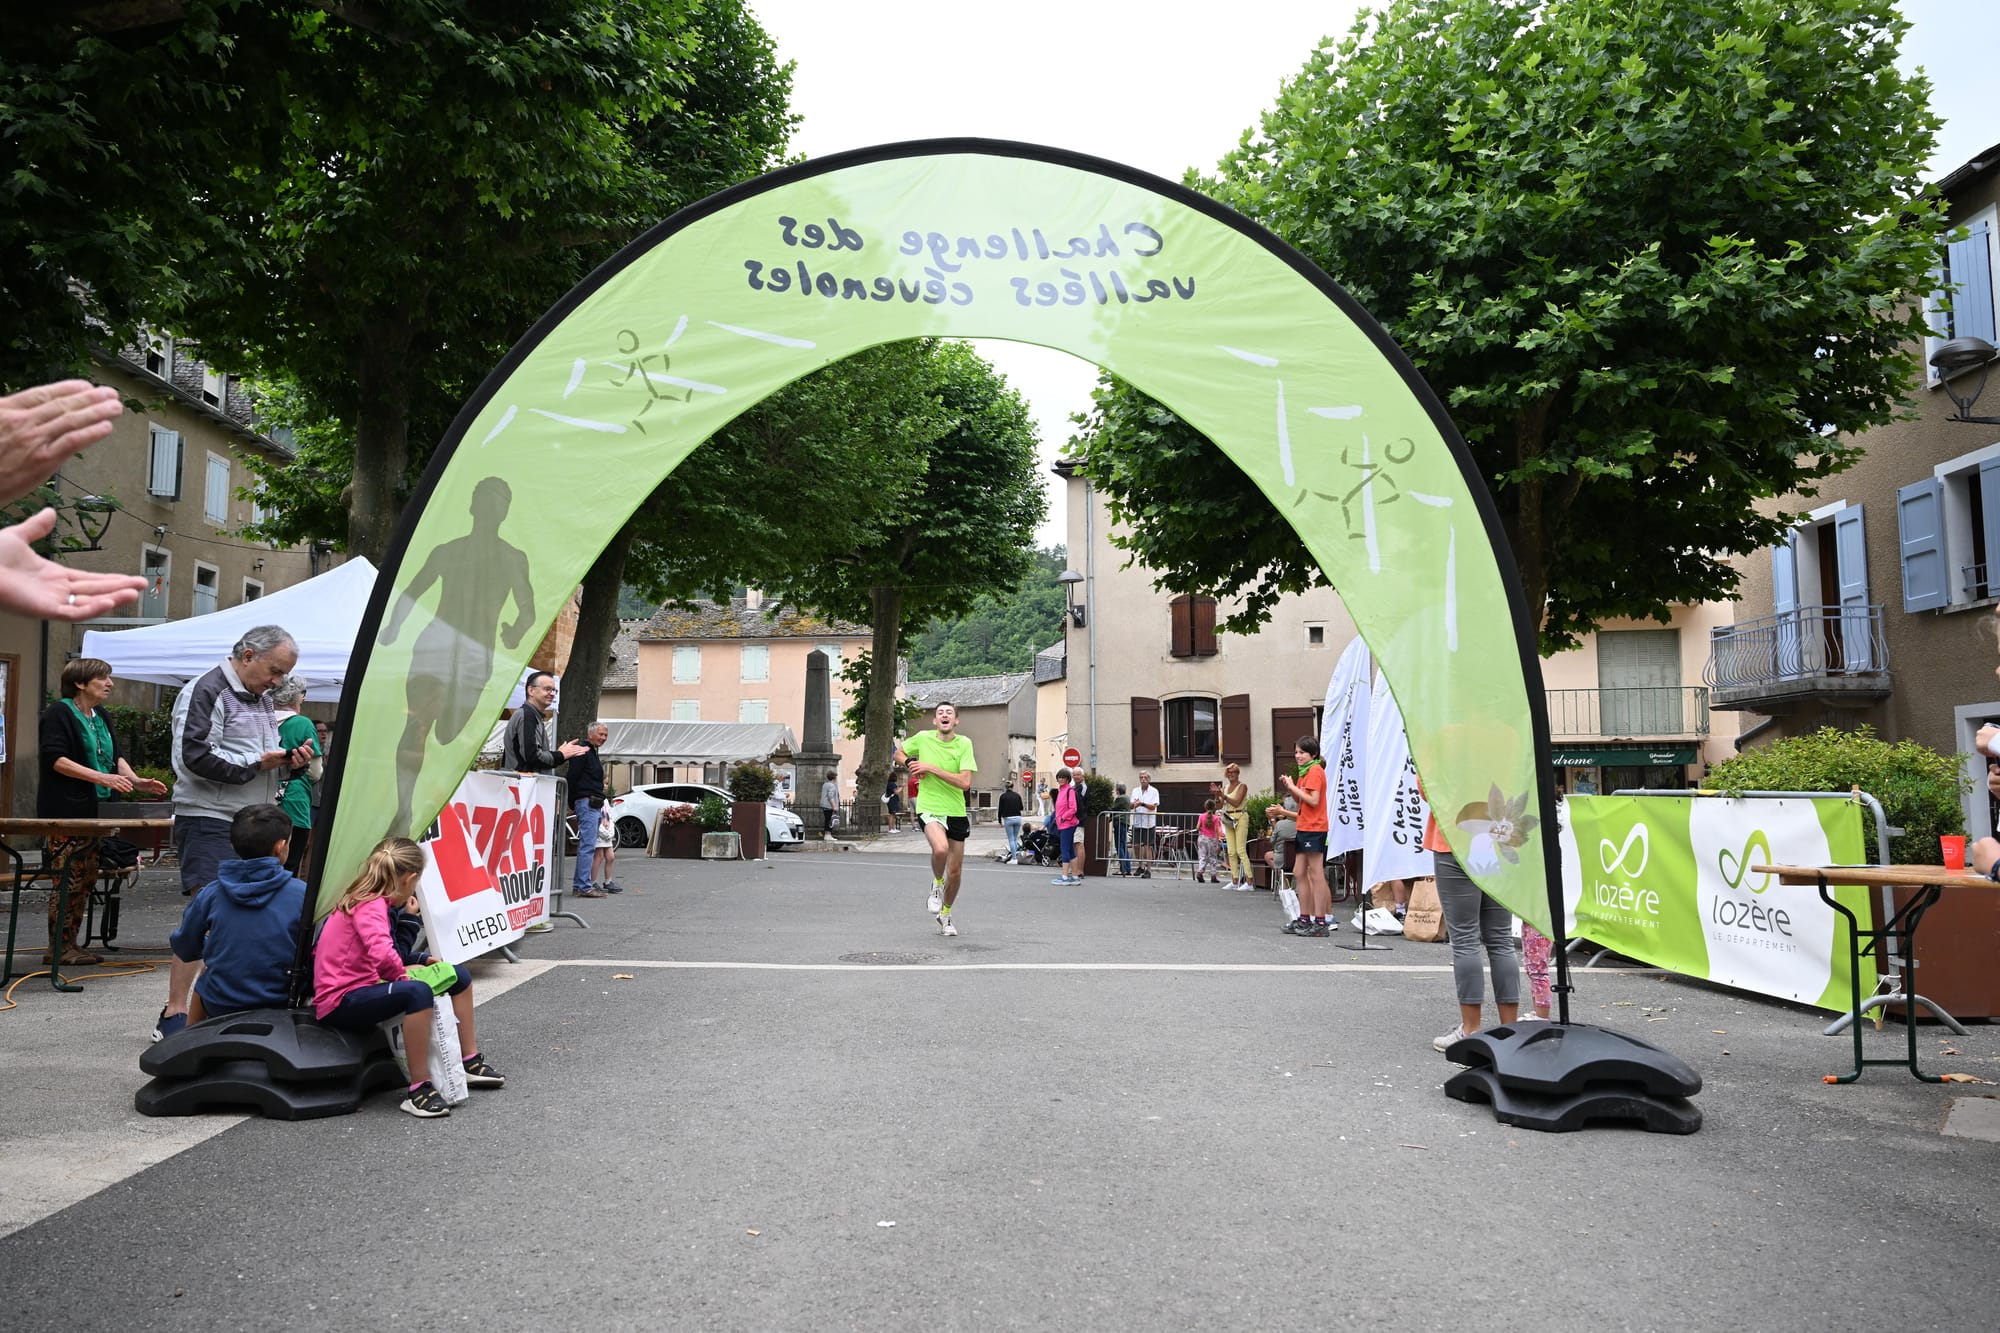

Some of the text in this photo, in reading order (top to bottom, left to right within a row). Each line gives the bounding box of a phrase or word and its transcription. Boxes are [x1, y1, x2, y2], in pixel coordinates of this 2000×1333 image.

[1551, 753, 1595, 766] drome
[1347, 778, 1365, 831] vallées
[1406, 787, 1424, 854] vallées
[1595, 880, 1660, 915] lozère
[1712, 894, 1793, 937] lozère
[1726, 931, 1798, 954] DÉPARTEMENT
